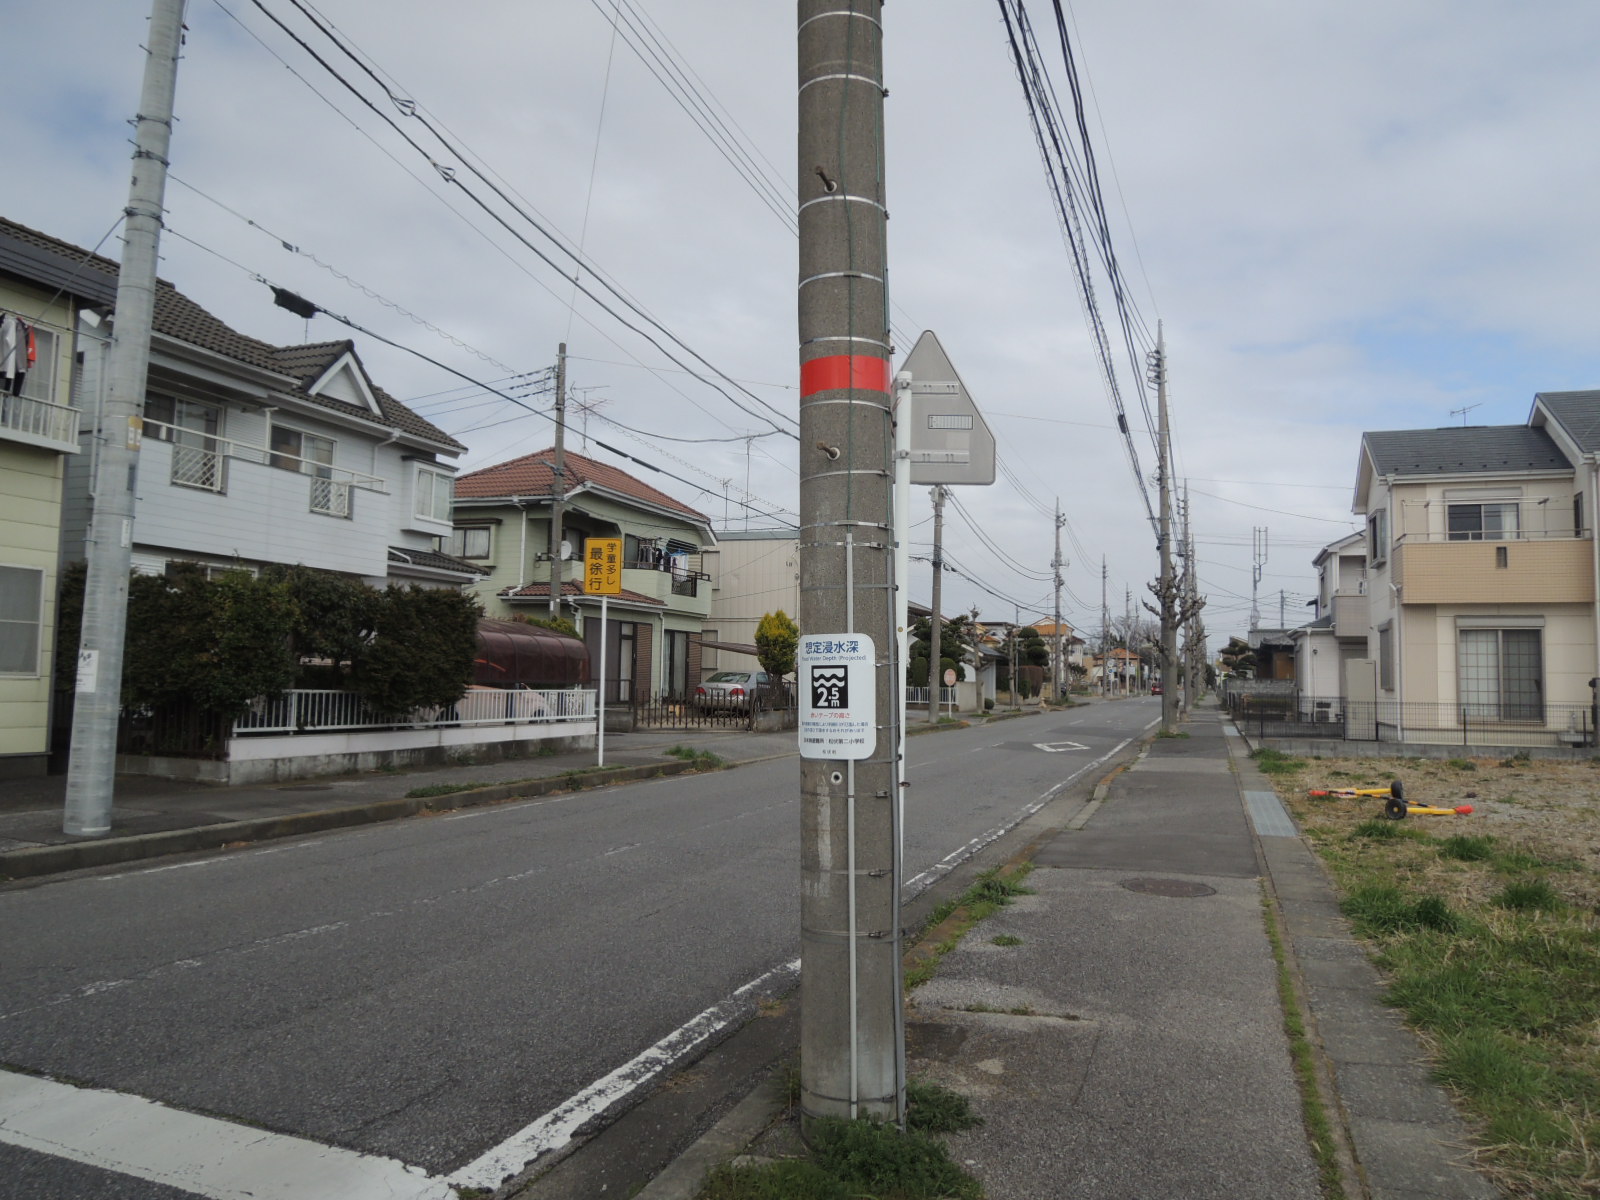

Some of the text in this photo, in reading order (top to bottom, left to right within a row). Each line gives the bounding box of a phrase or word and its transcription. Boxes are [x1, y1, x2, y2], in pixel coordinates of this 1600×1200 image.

[589, 547, 603, 591] 最徐行
[607, 542, 617, 585] 学童多し
[805, 640, 859, 654] 想定浸水深
